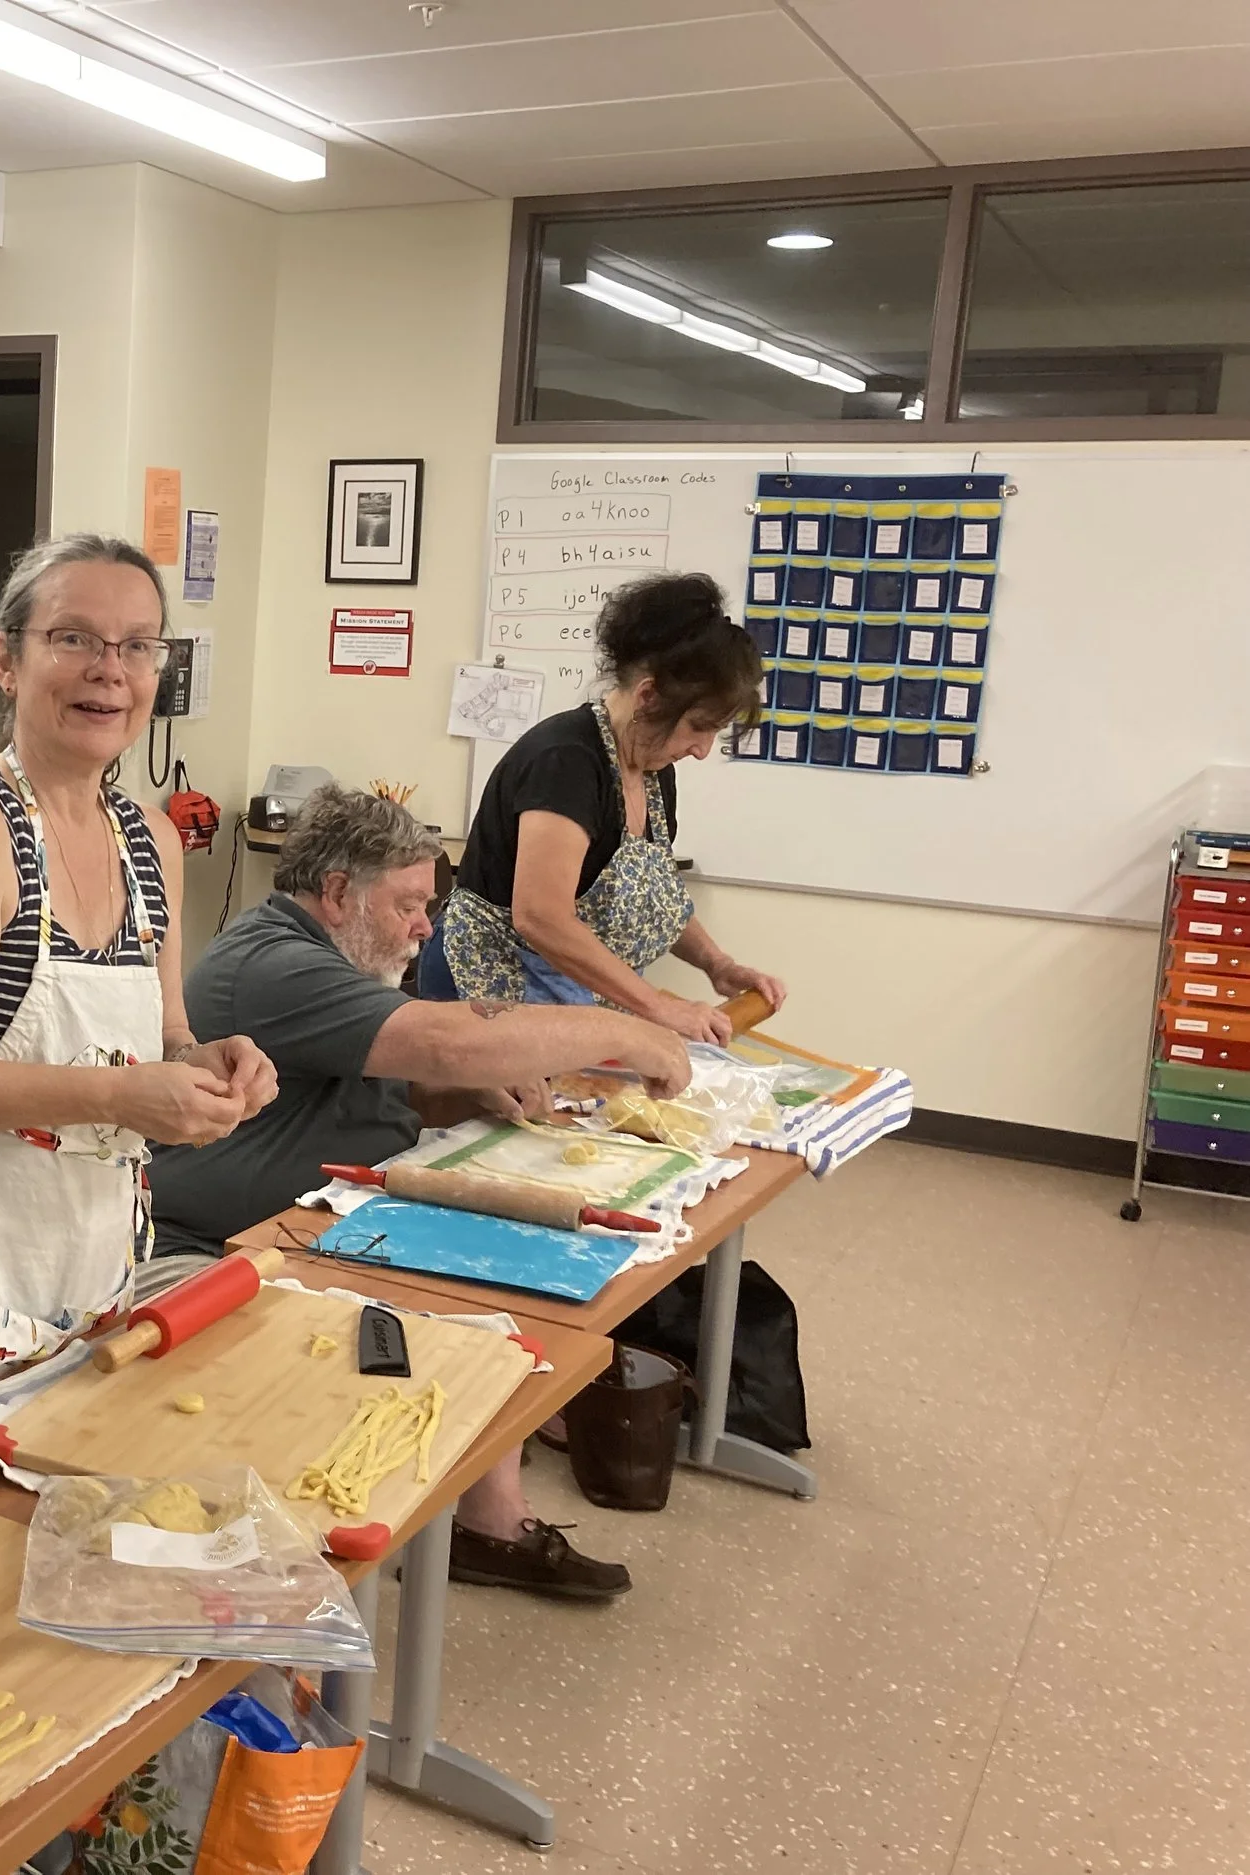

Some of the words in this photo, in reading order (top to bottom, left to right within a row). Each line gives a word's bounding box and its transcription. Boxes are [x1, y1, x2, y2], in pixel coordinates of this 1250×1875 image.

[550, 470, 594, 493] Google
[604, 471, 670, 485] Classroom
[680, 472, 716, 484] Codes
[558, 666, 583, 689] my
